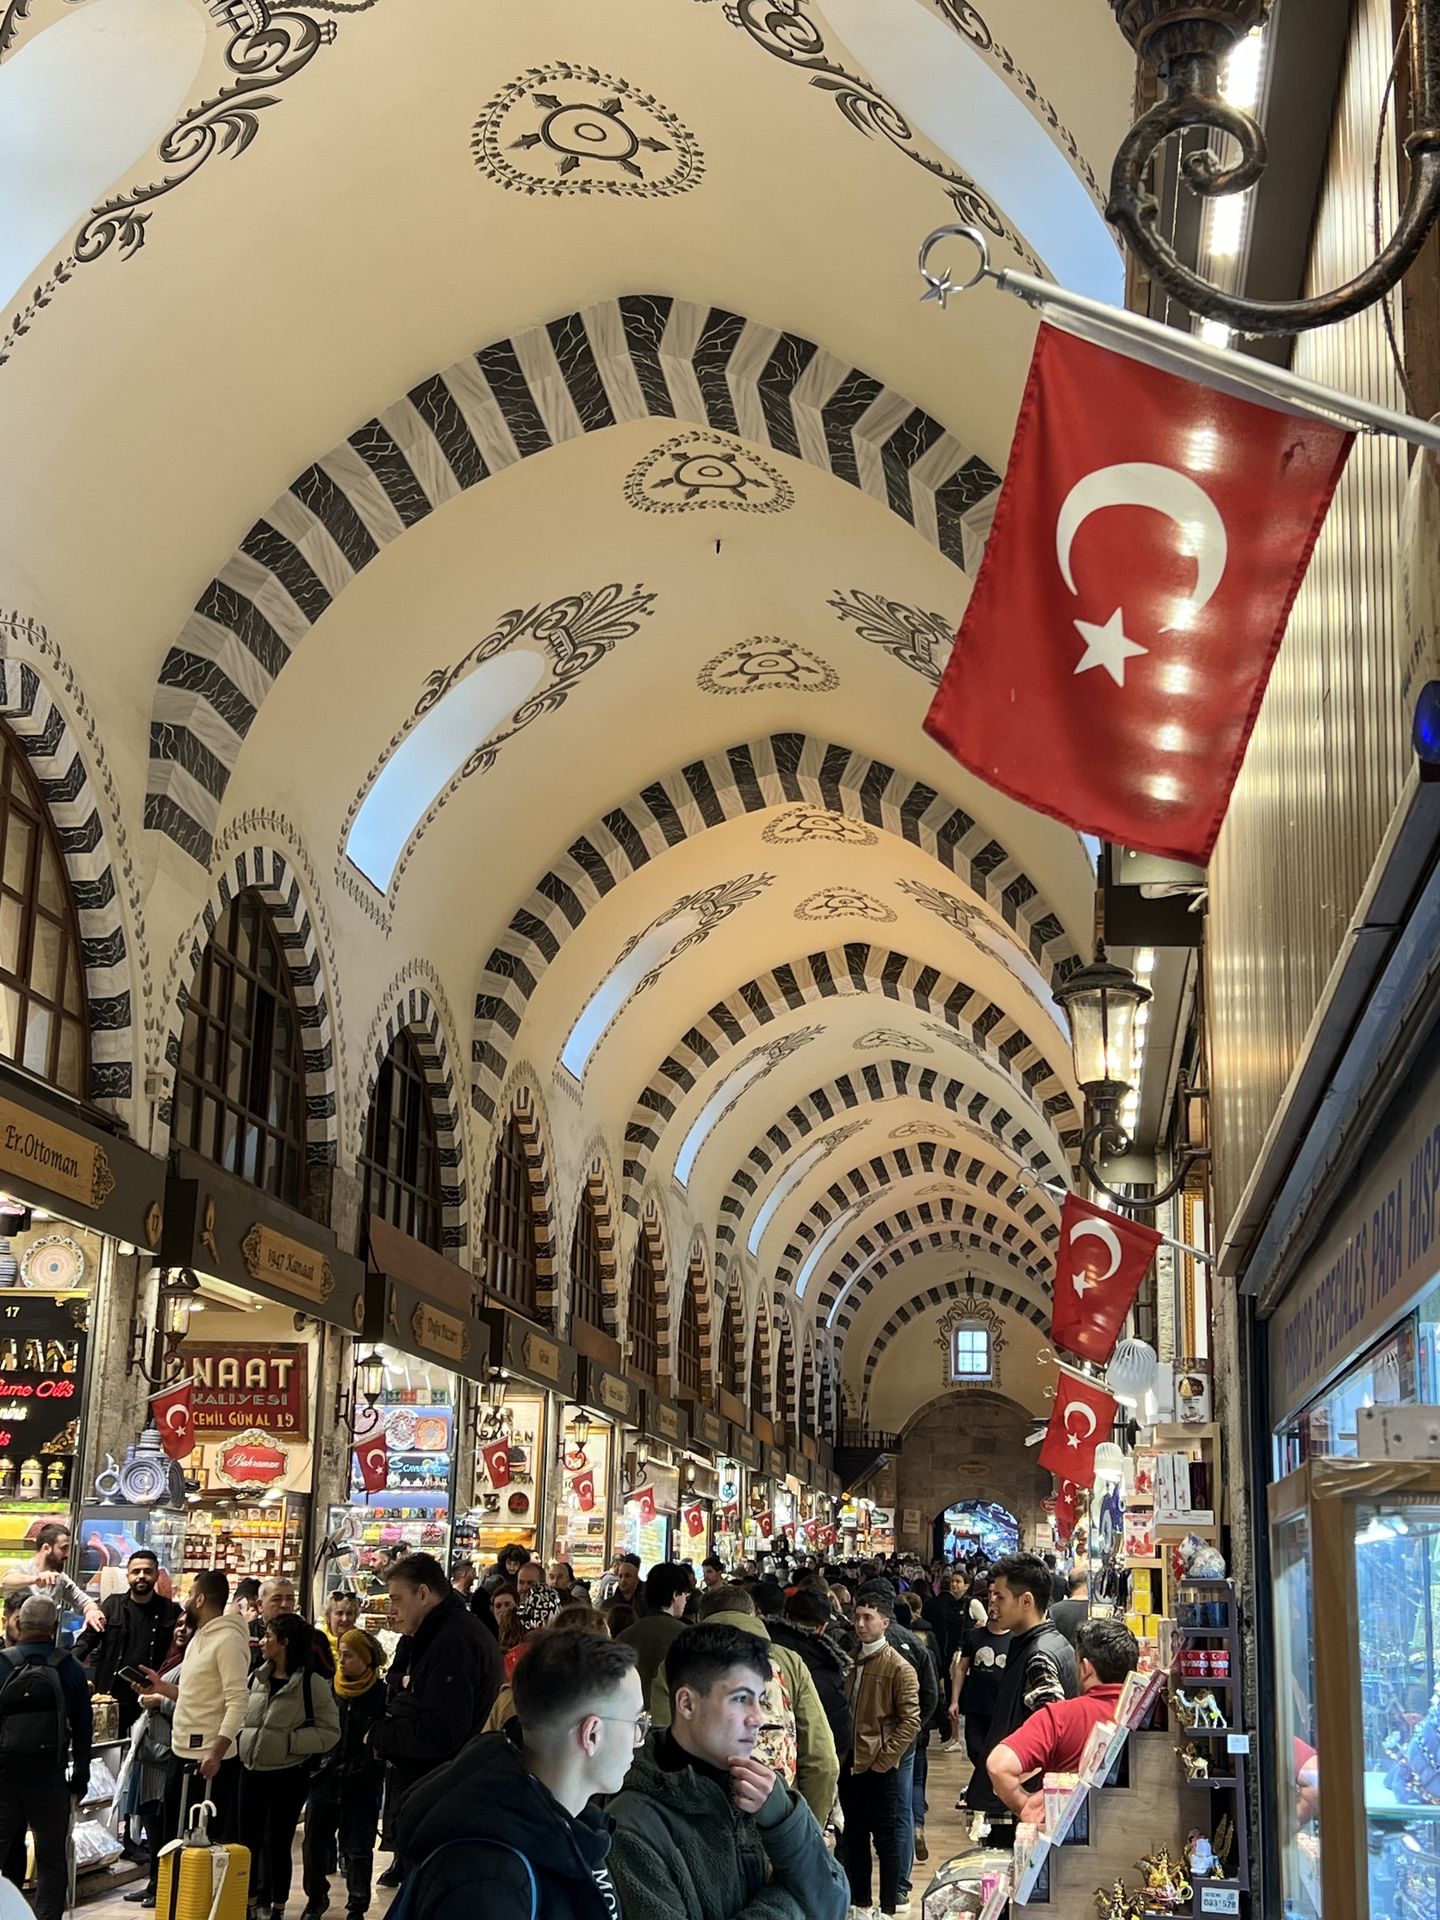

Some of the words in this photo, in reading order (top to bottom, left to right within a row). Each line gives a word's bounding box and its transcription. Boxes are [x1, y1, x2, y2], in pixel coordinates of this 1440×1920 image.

[5, 1124, 79, 1178] Er.Ottoman
[1370, 1177, 1403, 1310] PARA
[267, 1248, 285, 1271] 1947
[5, 1306, 20, 1318] 17
[36, 1380, 75, 1398] Oils
[192, 1411, 226, 1426] CEMİL
[276, 1413, 295, 1428] 19
